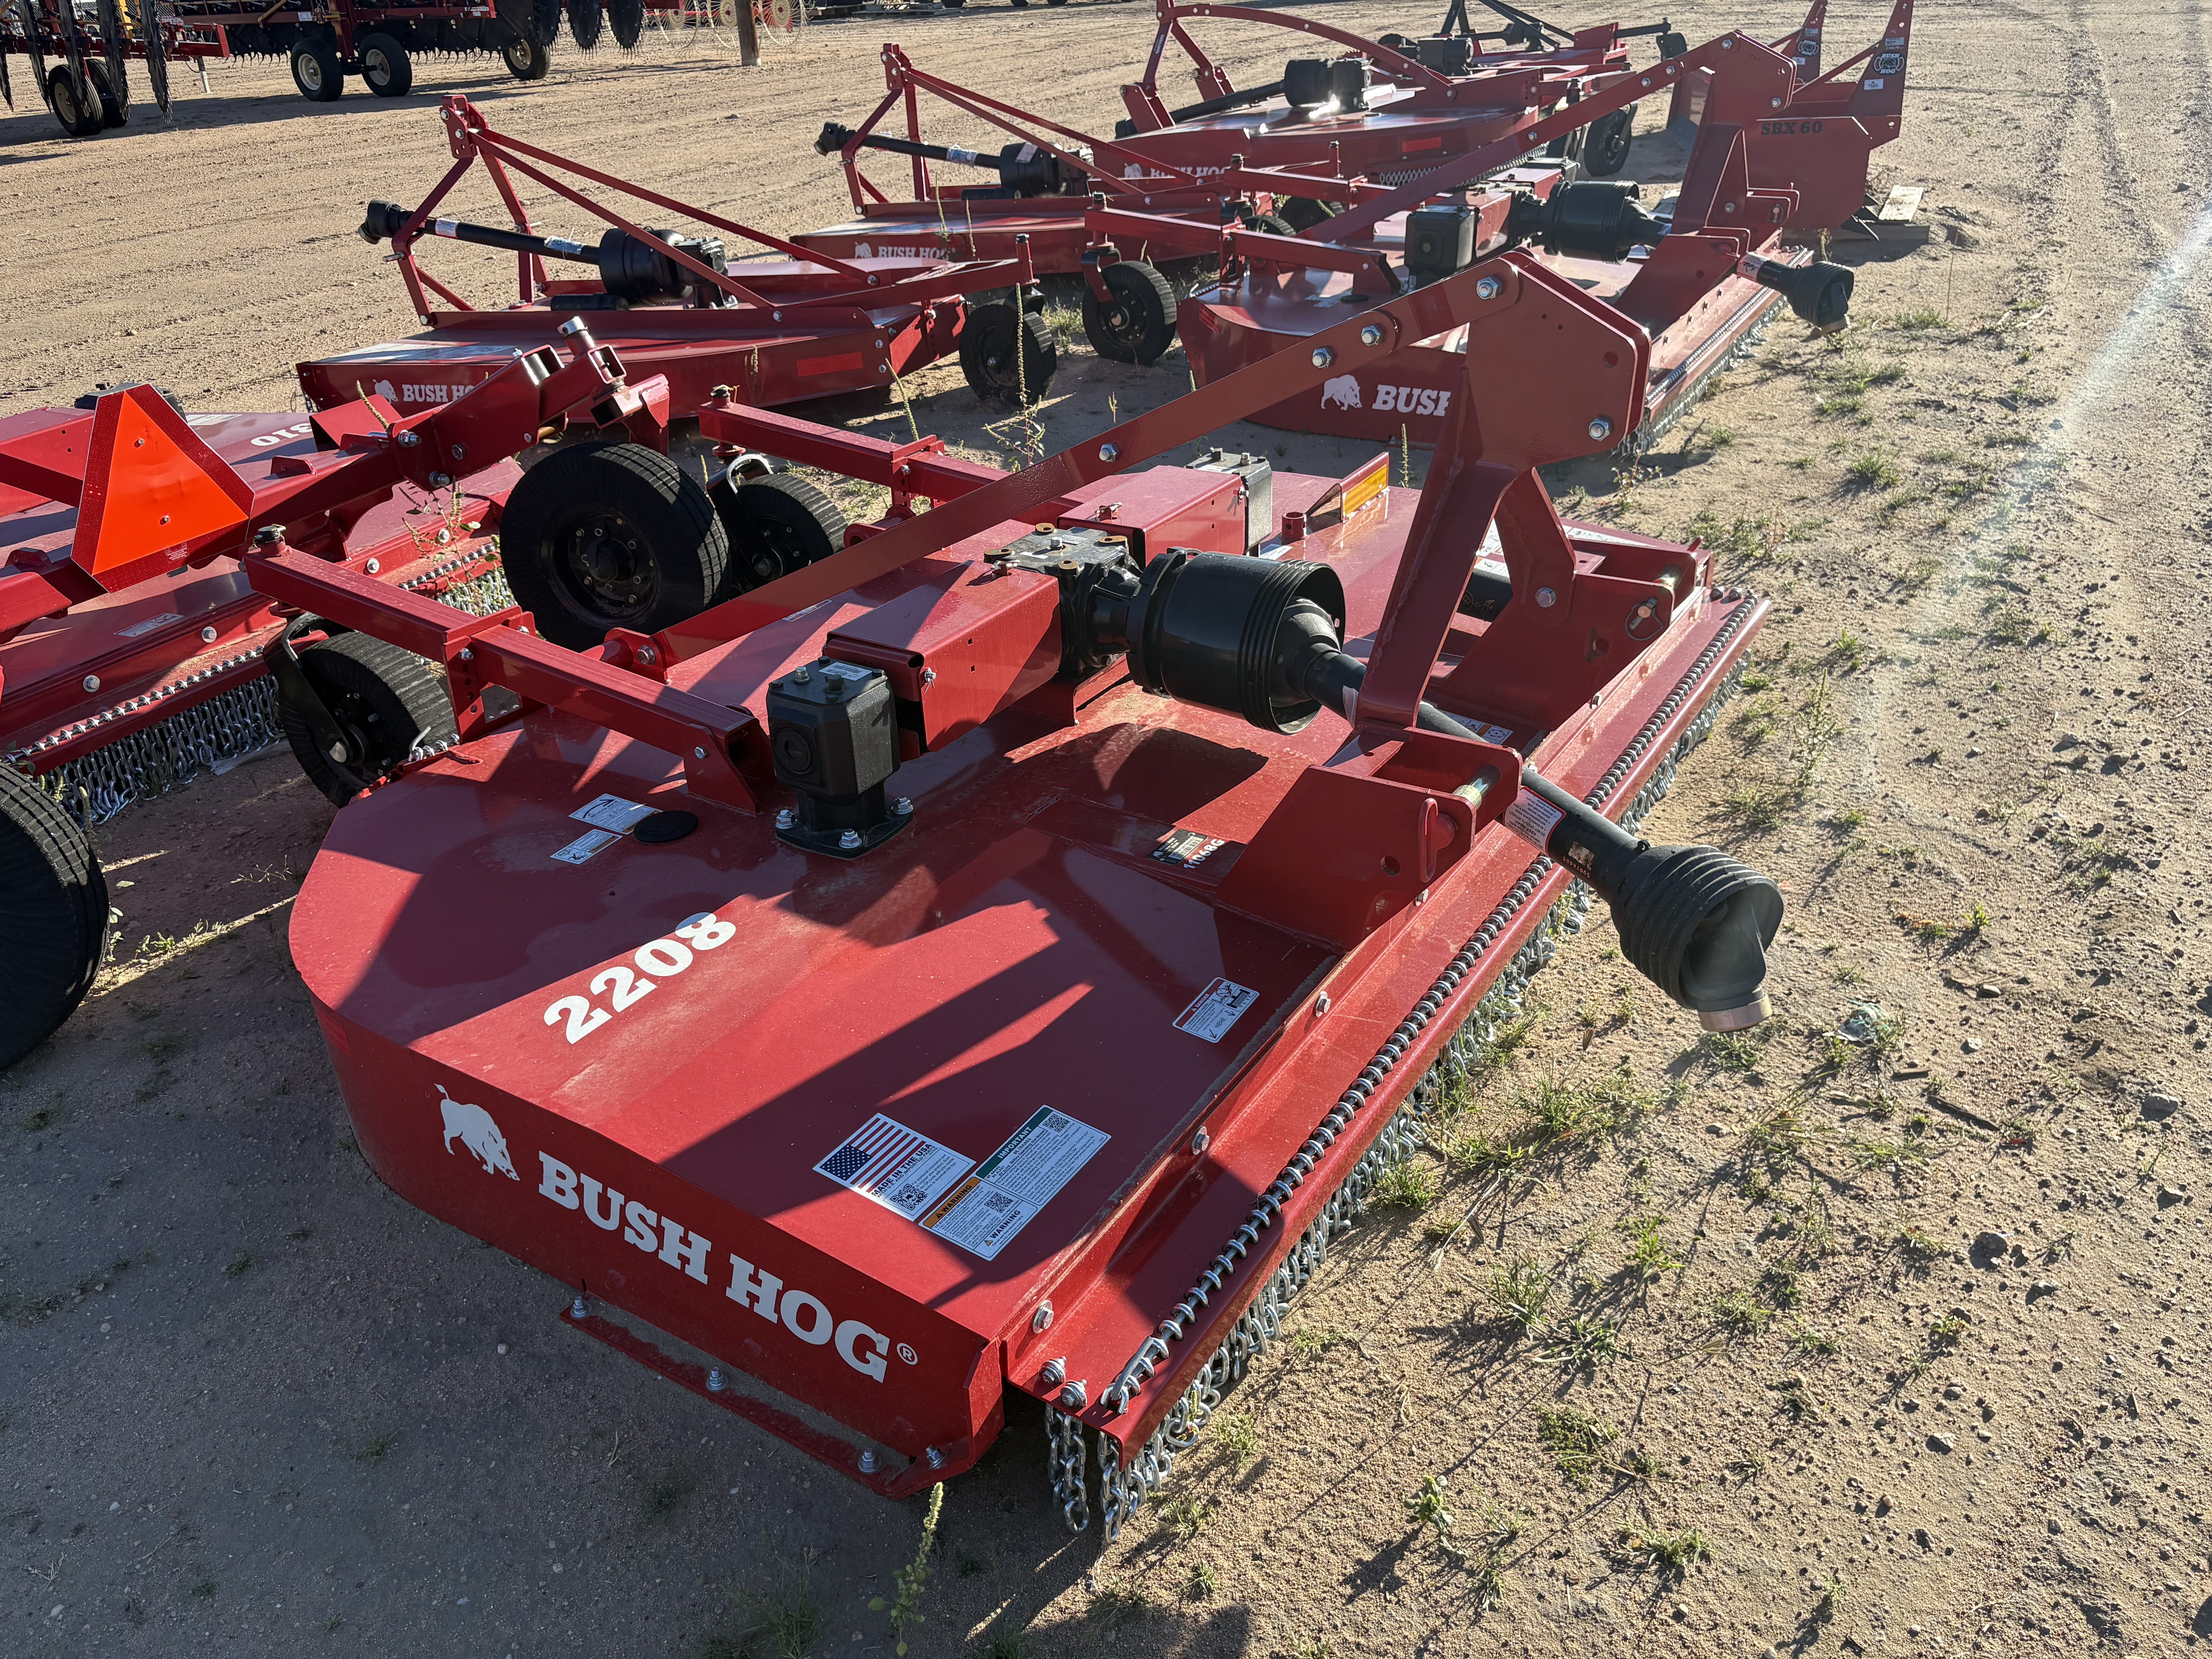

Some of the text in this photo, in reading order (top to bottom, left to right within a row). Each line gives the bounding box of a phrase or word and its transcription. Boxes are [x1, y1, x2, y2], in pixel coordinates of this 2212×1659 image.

[1761, 121, 1822, 135] SBX 60
[878, 246, 916, 258] BUSH
[402, 384, 448, 402] BUSH
[1521, 819, 1534, 829] OPERATE
[1526, 827, 1536, 836] KEEP
[1183, 838, 1225, 869] 11068G
[544, 912, 736, 1044] 2208
[1194, 993, 1210, 1007] DANGER
[1214, 1017, 1226, 1028] HERE
[996, 1126, 1033, 1159] IMPORTANT
[871, 1177, 894, 1196] MADE
[891, 1170, 902, 1178] IN
[900, 1156, 917, 1170] THE
[915, 1143, 932, 1156] USA
[903, 1156, 923, 1174] IMPORTED
[941, 1184, 972, 1212] WARNING
[539, 1151, 711, 1285] BUSH
[989, 1209, 1021, 1239] WARNING
